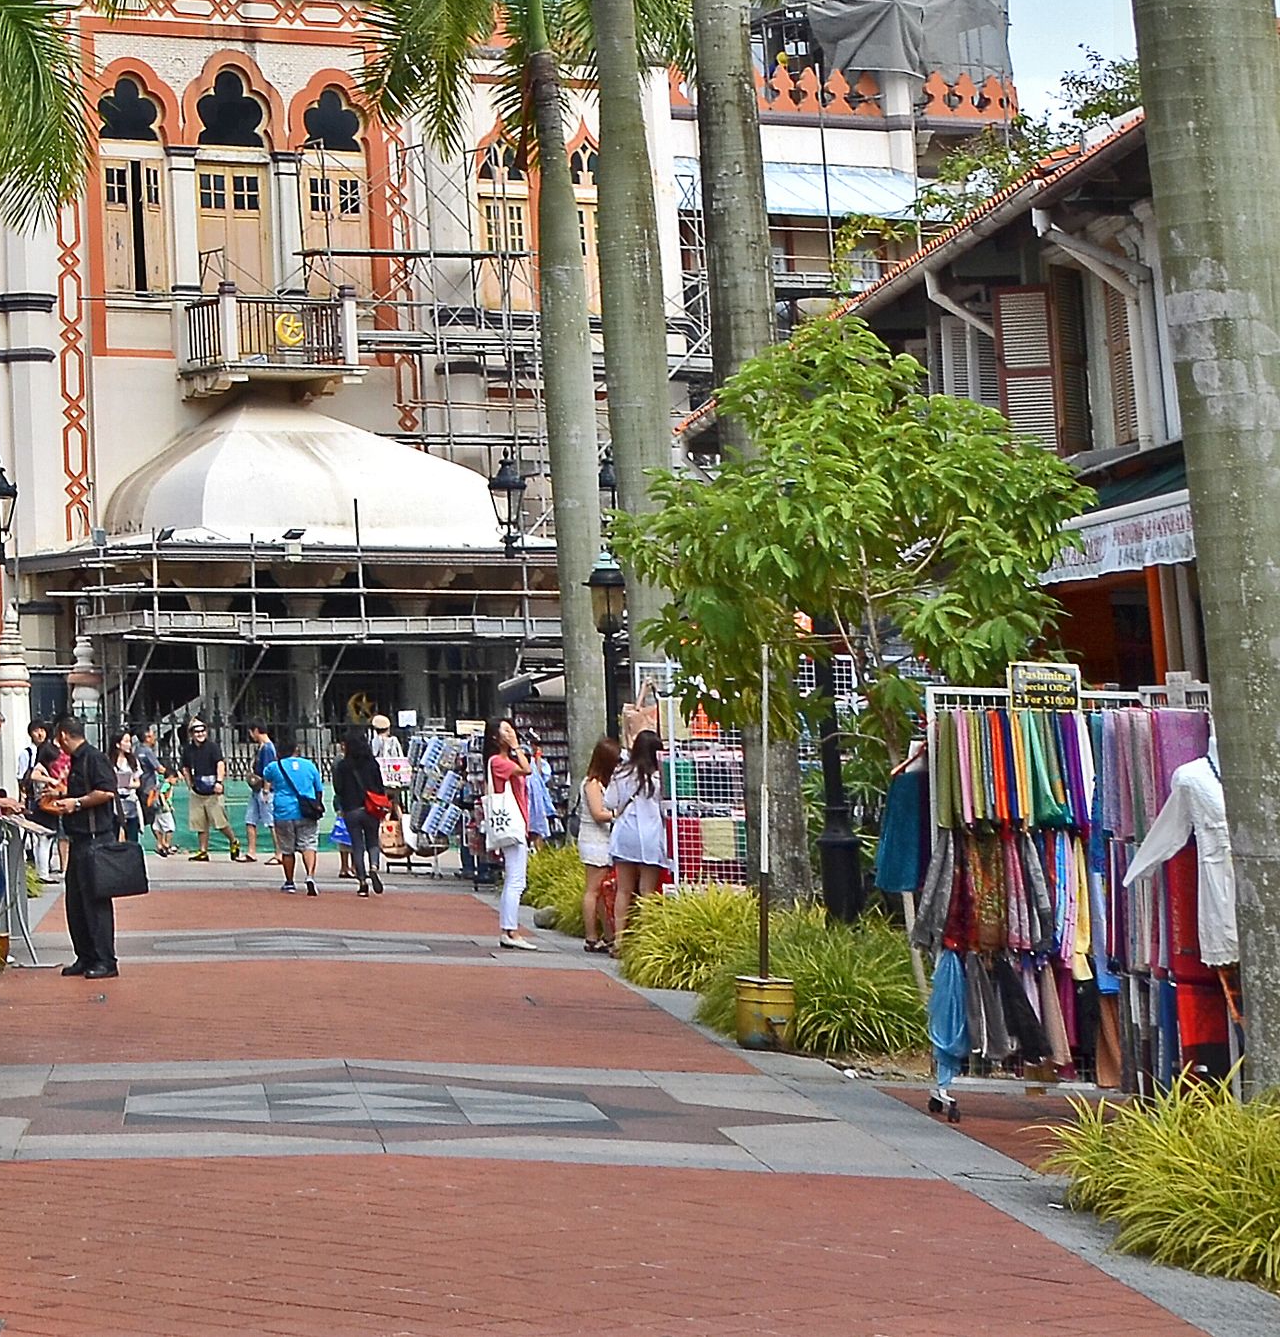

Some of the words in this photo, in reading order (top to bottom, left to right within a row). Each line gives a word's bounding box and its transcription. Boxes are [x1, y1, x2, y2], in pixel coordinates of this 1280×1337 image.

[1018, 669, 1072, 681] Pashmina
[1049, 684, 1072, 692] Offer
[1015, 693, 1023, 704] 2
[1024, 694, 1042, 704] For
